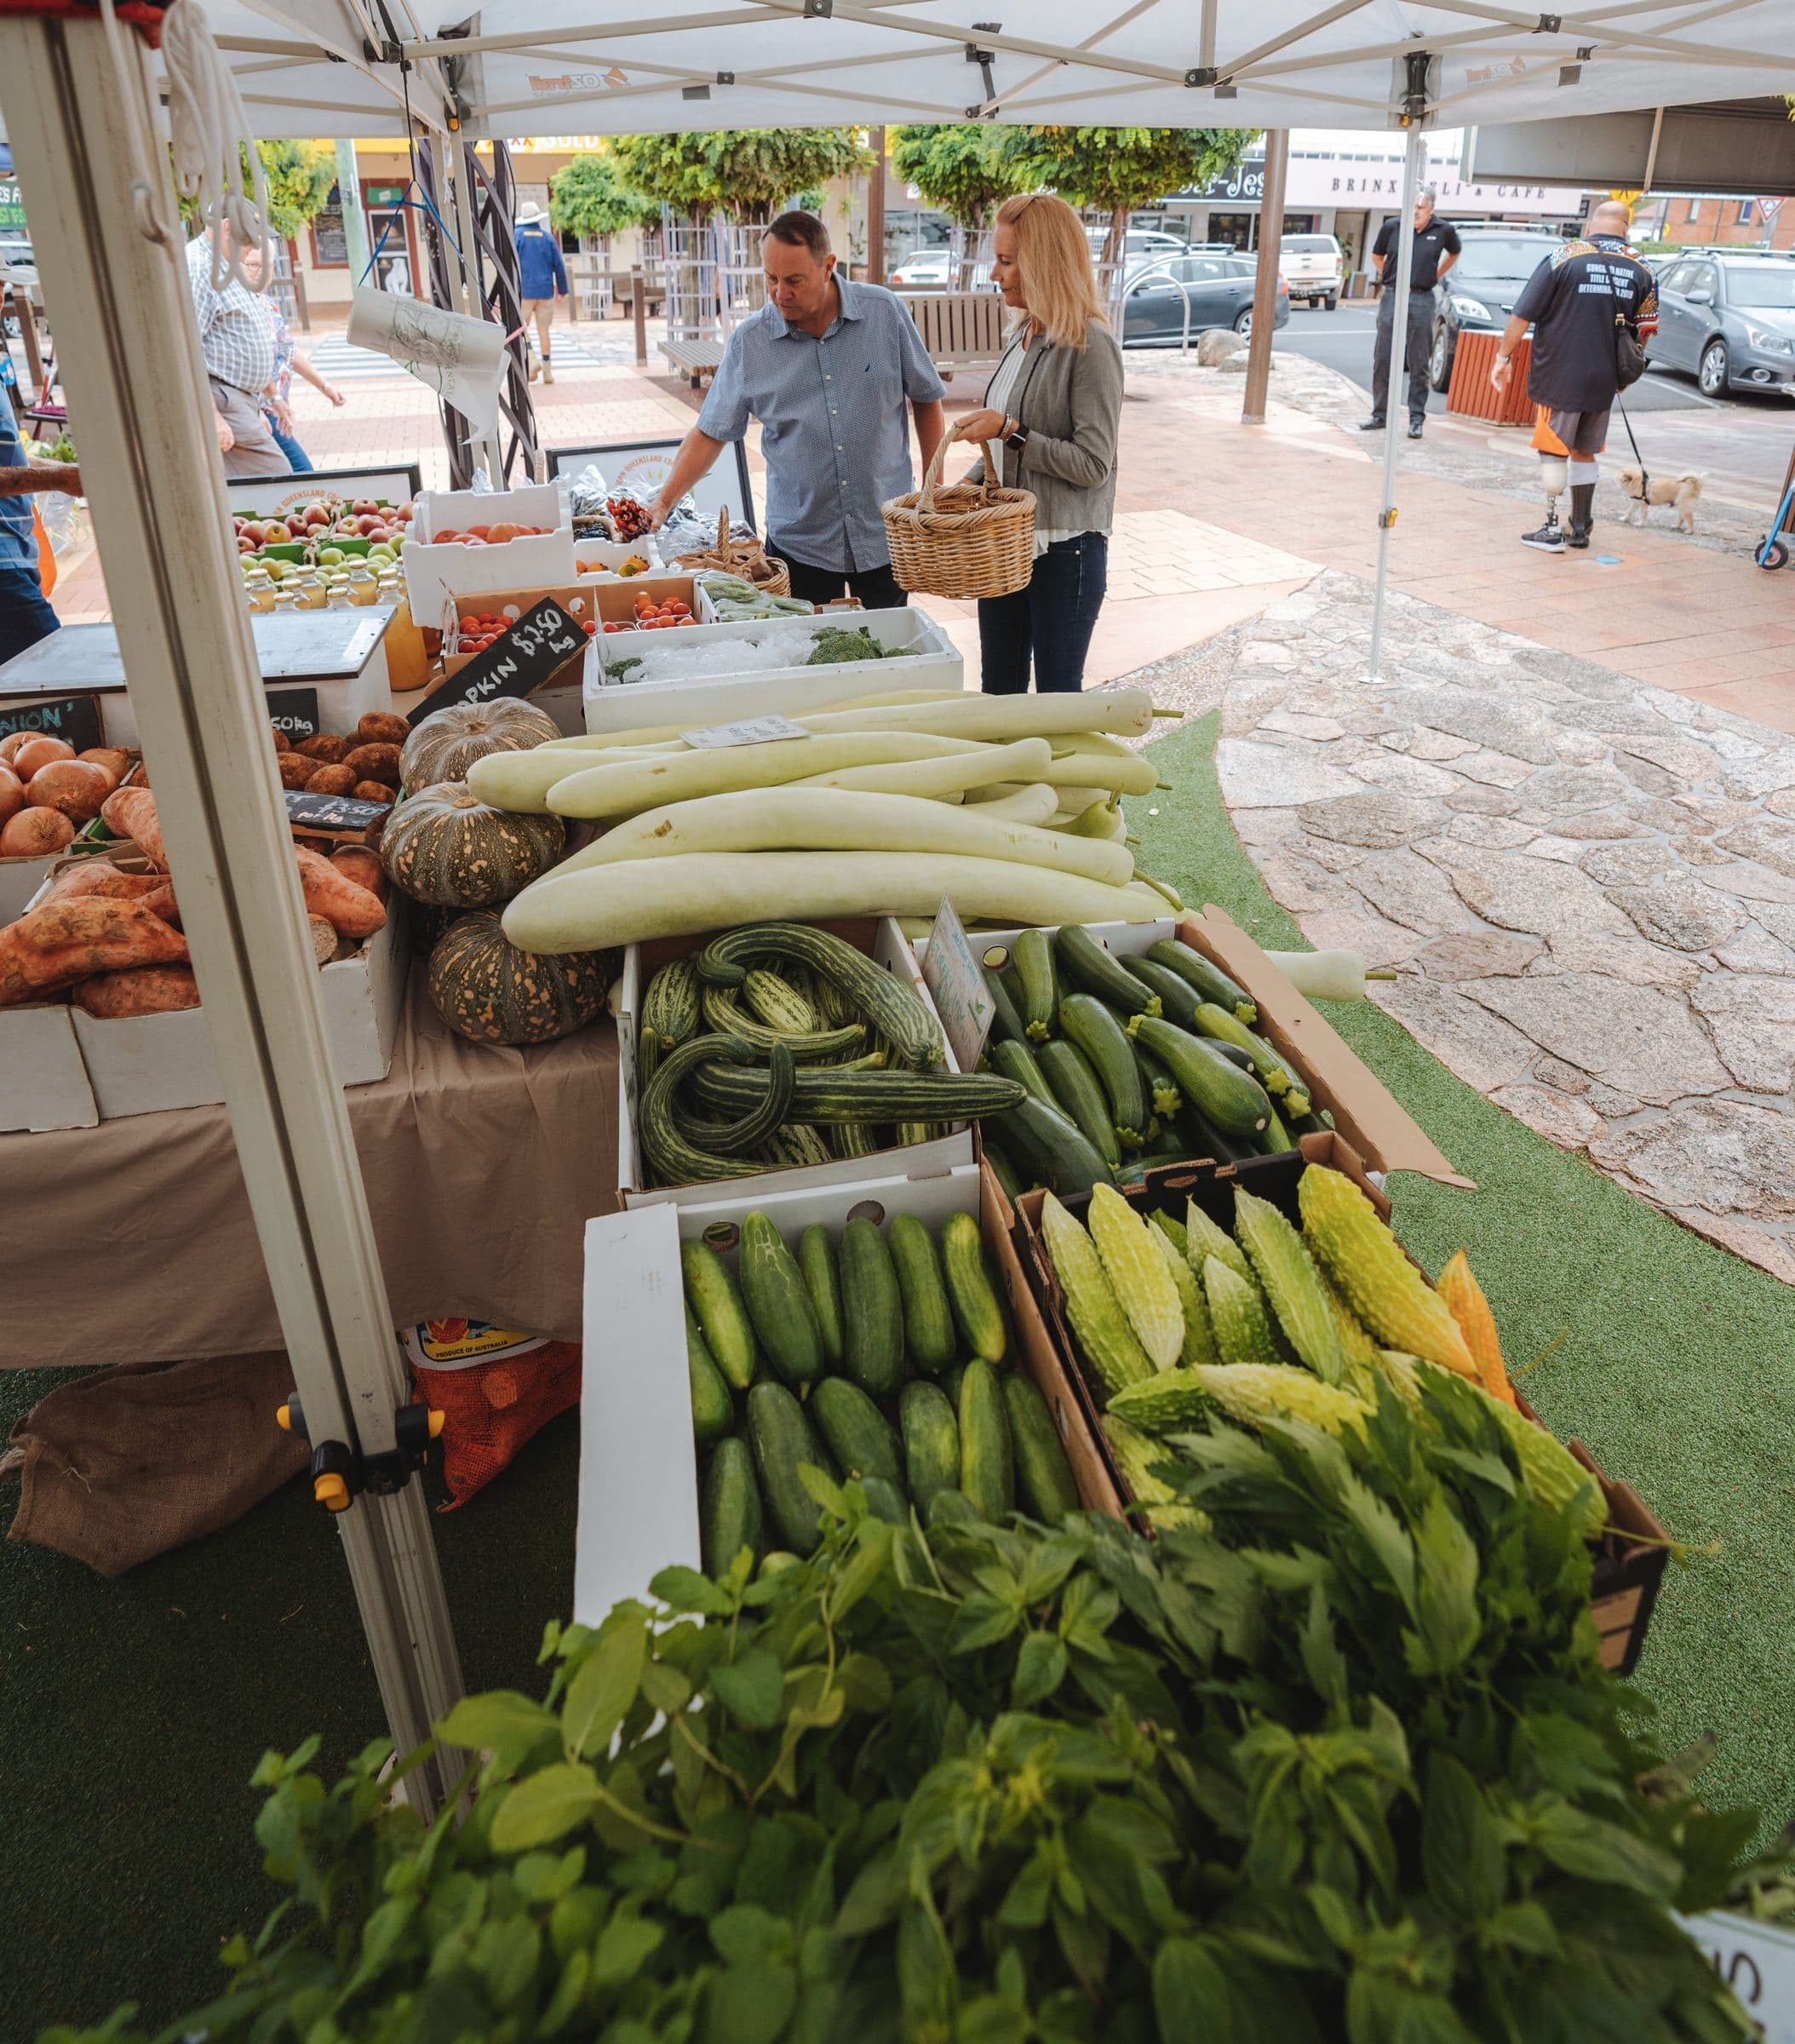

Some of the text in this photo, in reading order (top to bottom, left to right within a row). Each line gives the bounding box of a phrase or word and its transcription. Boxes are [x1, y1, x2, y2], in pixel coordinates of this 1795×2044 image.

[1331, 177, 1397, 193] BRINX
[1590, 273, 1605, 284] TITLE
[282, 490, 325, 507] QUEENSLAND
[435, 1347, 465, 1358] PRODUCE
[474, 1339, 508, 1352] AUSTRALIA
